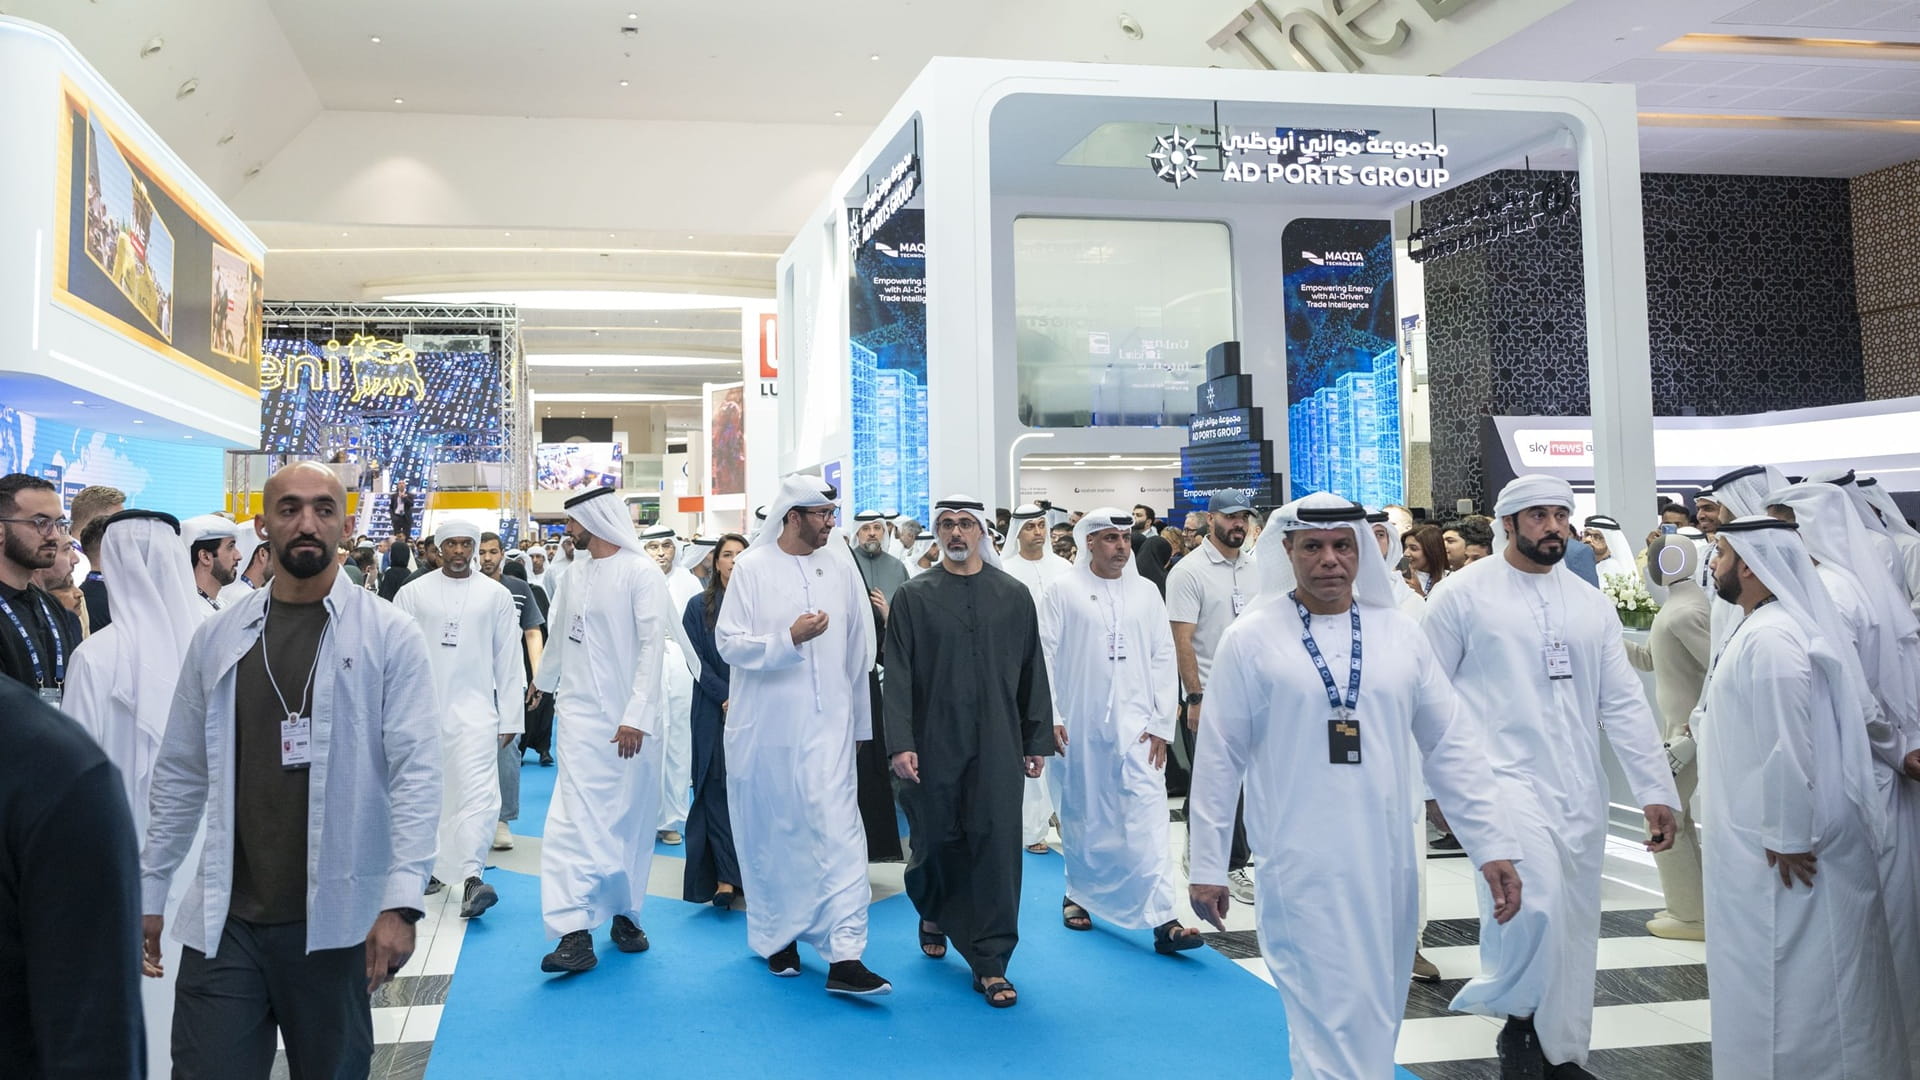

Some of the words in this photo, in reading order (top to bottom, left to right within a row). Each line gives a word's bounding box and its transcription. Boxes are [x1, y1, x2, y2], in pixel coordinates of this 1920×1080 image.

[1366, 133, 1449, 159] مجموعة
[1223, 162, 1262, 183] AD
[1267, 163, 1355, 186] PORTS
[1359, 165, 1450, 188] GROUP
[862, 221, 871, 244] AD
[870, 200, 890, 235] PORTS
[890, 176, 914, 215] GROUP
[1325, 251, 1364, 261] MAQTA
[873, 277, 922, 287] Empowering
[1300, 283, 1347, 293] Empowering
[1347, 284, 1374, 294] Energy
[879, 294, 901, 302] Trade
[1311, 292, 1328, 300] with
[1328, 292, 1364, 301] AI-Driven
[1306, 300, 1328, 308] Trade
[1327, 301, 1370, 310] Intelligence
[261, 340, 342, 391] eni
[1192, 432, 1199, 441] AD
[1199, 429, 1217, 440] PORTS
[1216, 426, 1242, 438] GROUP
[1529, 441, 1548, 454] sky
[1551, 442, 1583, 454] news
[1183, 487, 1222, 499] Empoweri
